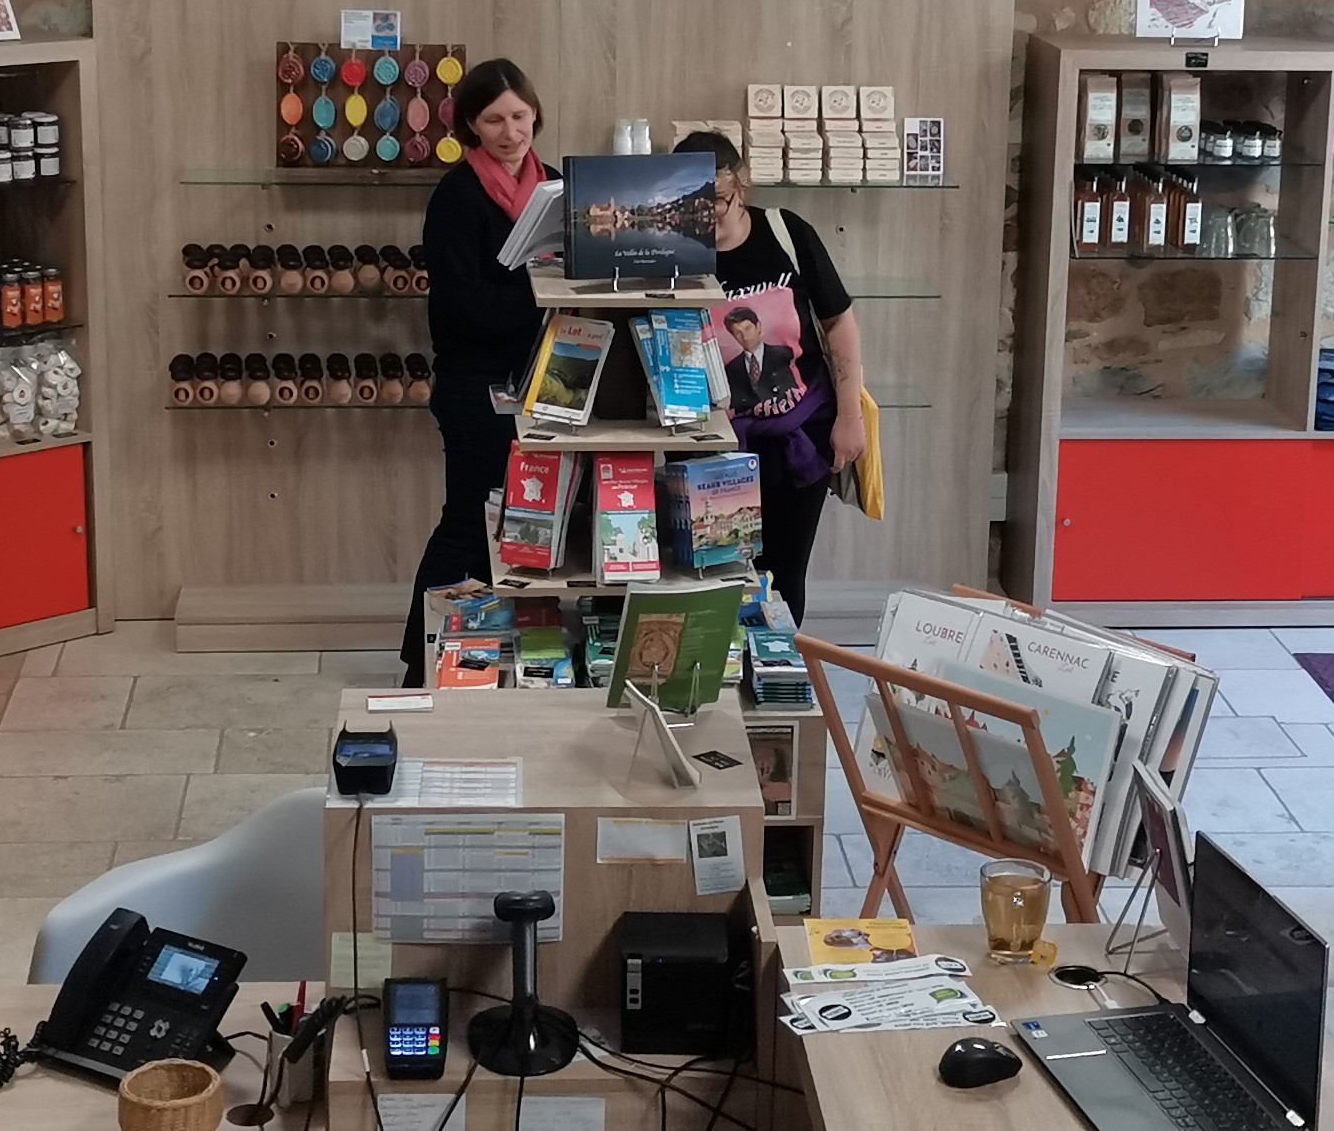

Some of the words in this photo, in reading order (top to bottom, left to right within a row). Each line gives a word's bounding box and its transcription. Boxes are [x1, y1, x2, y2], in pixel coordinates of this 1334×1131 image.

[567, 325, 583, 337] Lot
[519, 461, 550, 474] France
[696, 482, 721, 491] BEAUX
[722, 475, 755, 486] VILLAGES
[915, 619, 964, 645] LOUBRE
[1027, 641, 1090, 670] CARENNAC
